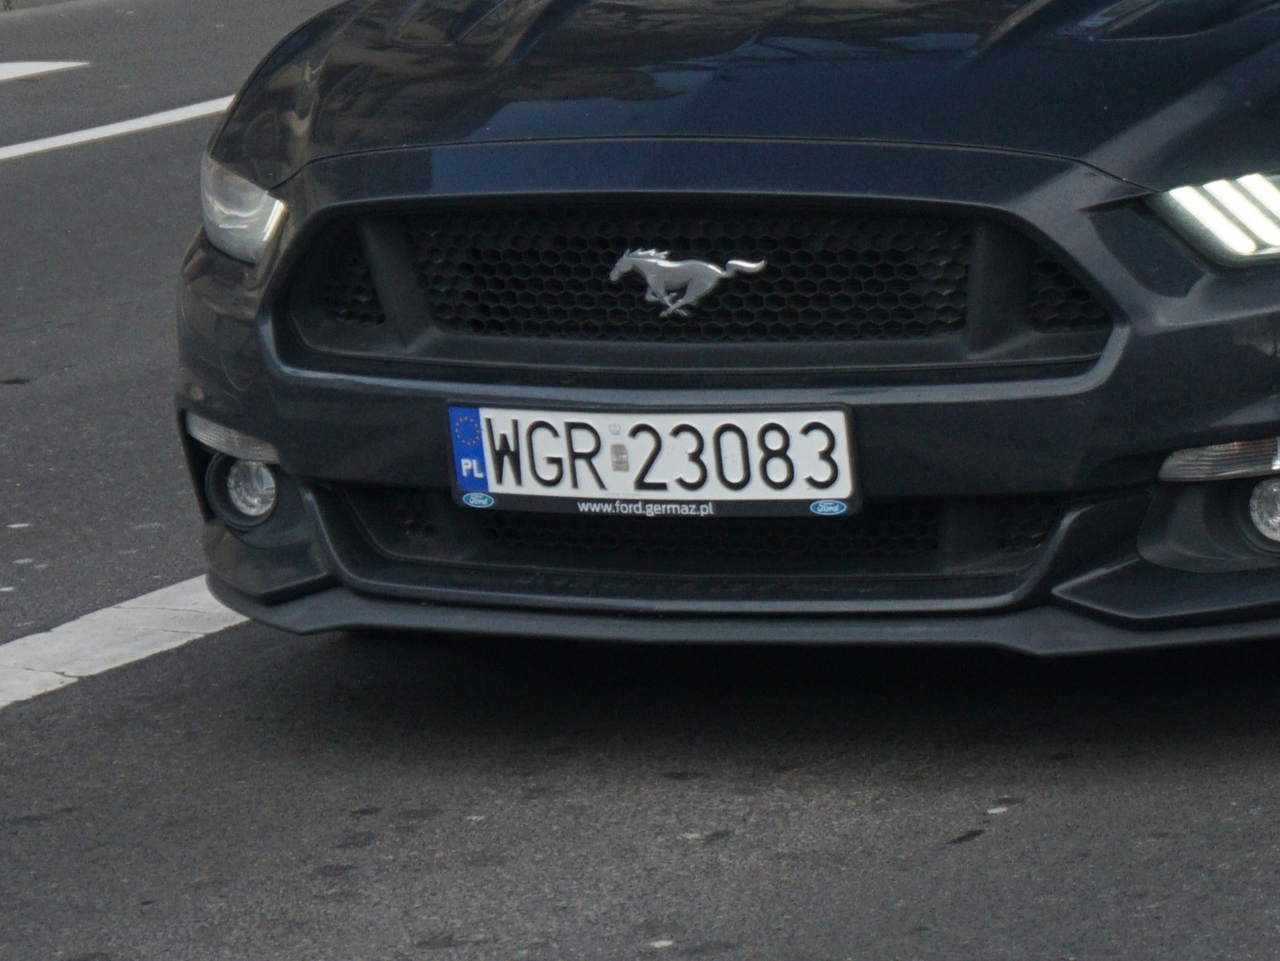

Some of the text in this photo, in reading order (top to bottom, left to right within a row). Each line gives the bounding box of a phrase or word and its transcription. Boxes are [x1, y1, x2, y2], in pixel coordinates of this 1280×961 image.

[484, 417, 840, 492] WGR 23083
[460, 457, 486, 479] PL
[576, 499, 714, 517] www.ford.germaz.pl
